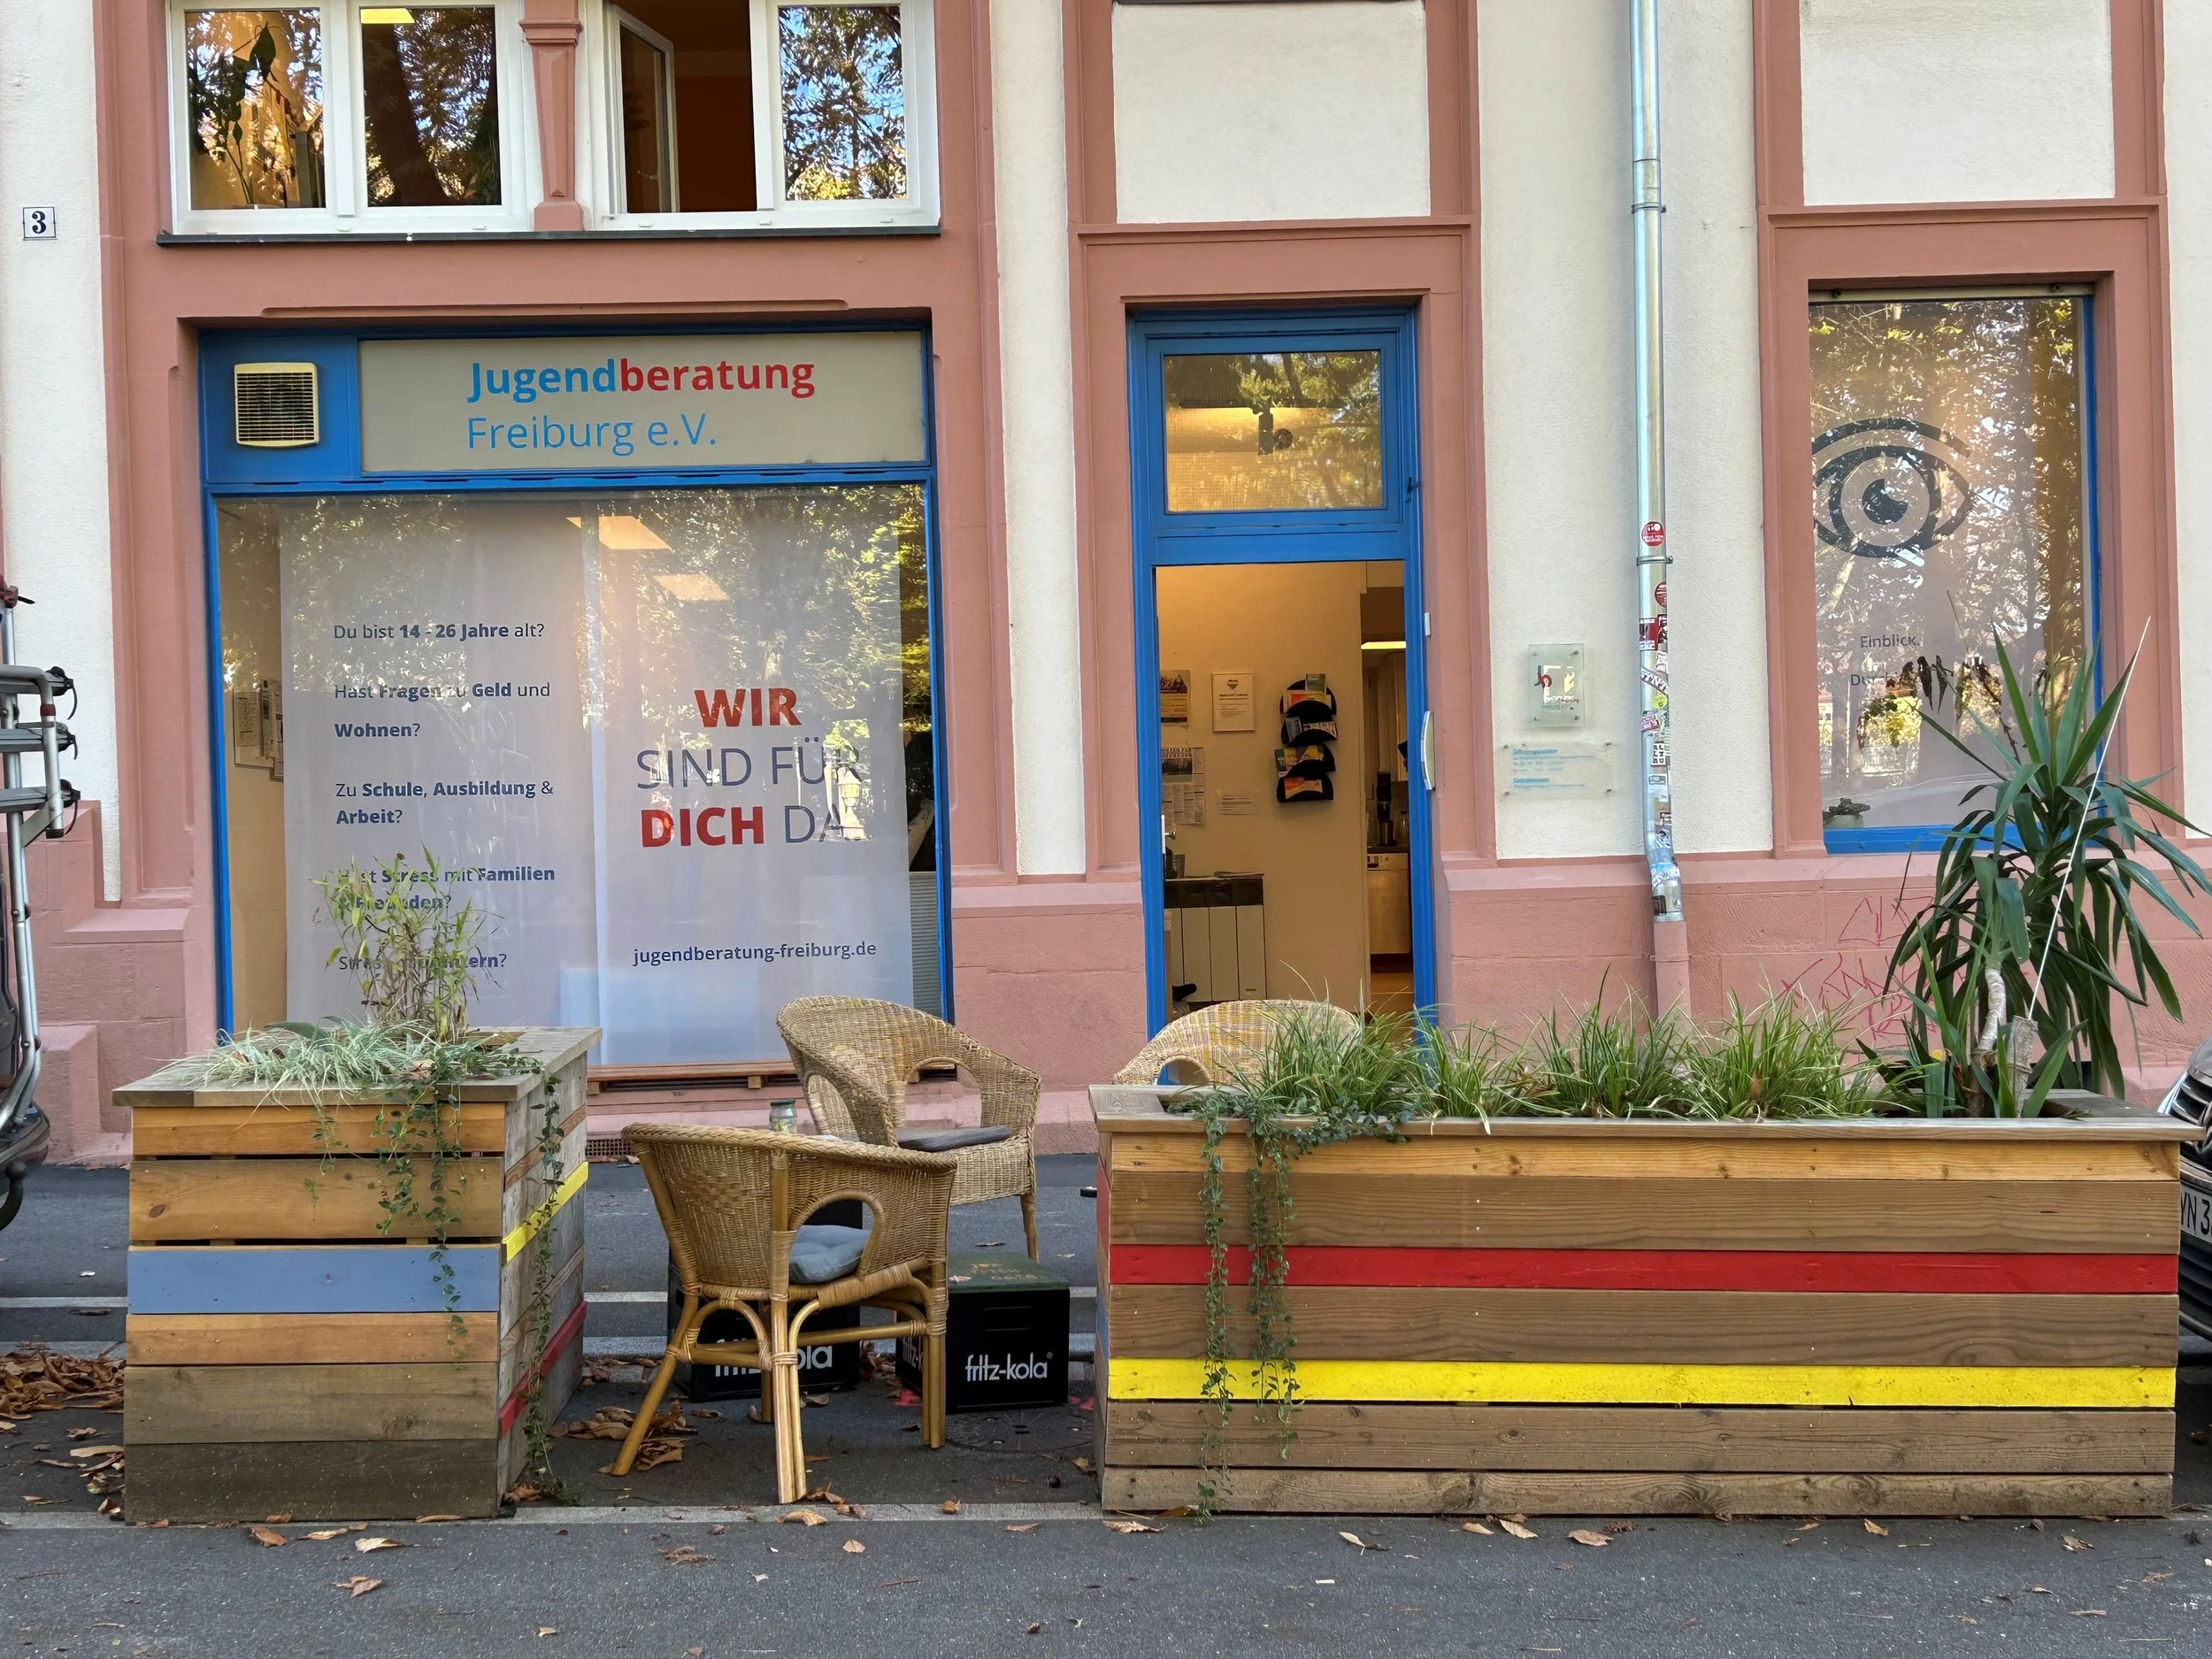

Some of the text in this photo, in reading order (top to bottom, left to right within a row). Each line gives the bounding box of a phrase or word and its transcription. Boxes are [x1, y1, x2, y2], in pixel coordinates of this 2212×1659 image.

[32, 211, 47, 234] 3
[466, 358, 815, 403] Jugendberatung
[467, 413, 716, 457] Freiburg e.V.
[334, 625, 357, 639] Du
[363, 624, 395, 639] bist
[399, 625, 420, 638] 14
[435, 624, 456, 638] 26
[460, 623, 509, 641] Jahre
[514, 623, 545, 638] alt?
[1860, 634, 1921, 649] Einblick.
[335, 684, 373, 699] Hast
[379, 684, 442, 703] Fragen
[472, 682, 511, 697] Geld
[518, 682, 550, 697] und
[694, 687, 803, 728] WIR
[334, 723, 420, 738] Wohnen?
[636, 748, 752, 789] SIND
[335, 780, 554, 798] Zu Schule, Ausbildung &
[335, 810, 403, 825] Arbeit?
[641, 806, 764, 848] DICH
[476, 865, 556, 882] Familien
[633, 941, 876, 966] jugendberatung-freiburg.de
[2200, 1198, 2212, 1237] 3
[965, 1352, 1048, 1382] fritz-kola
